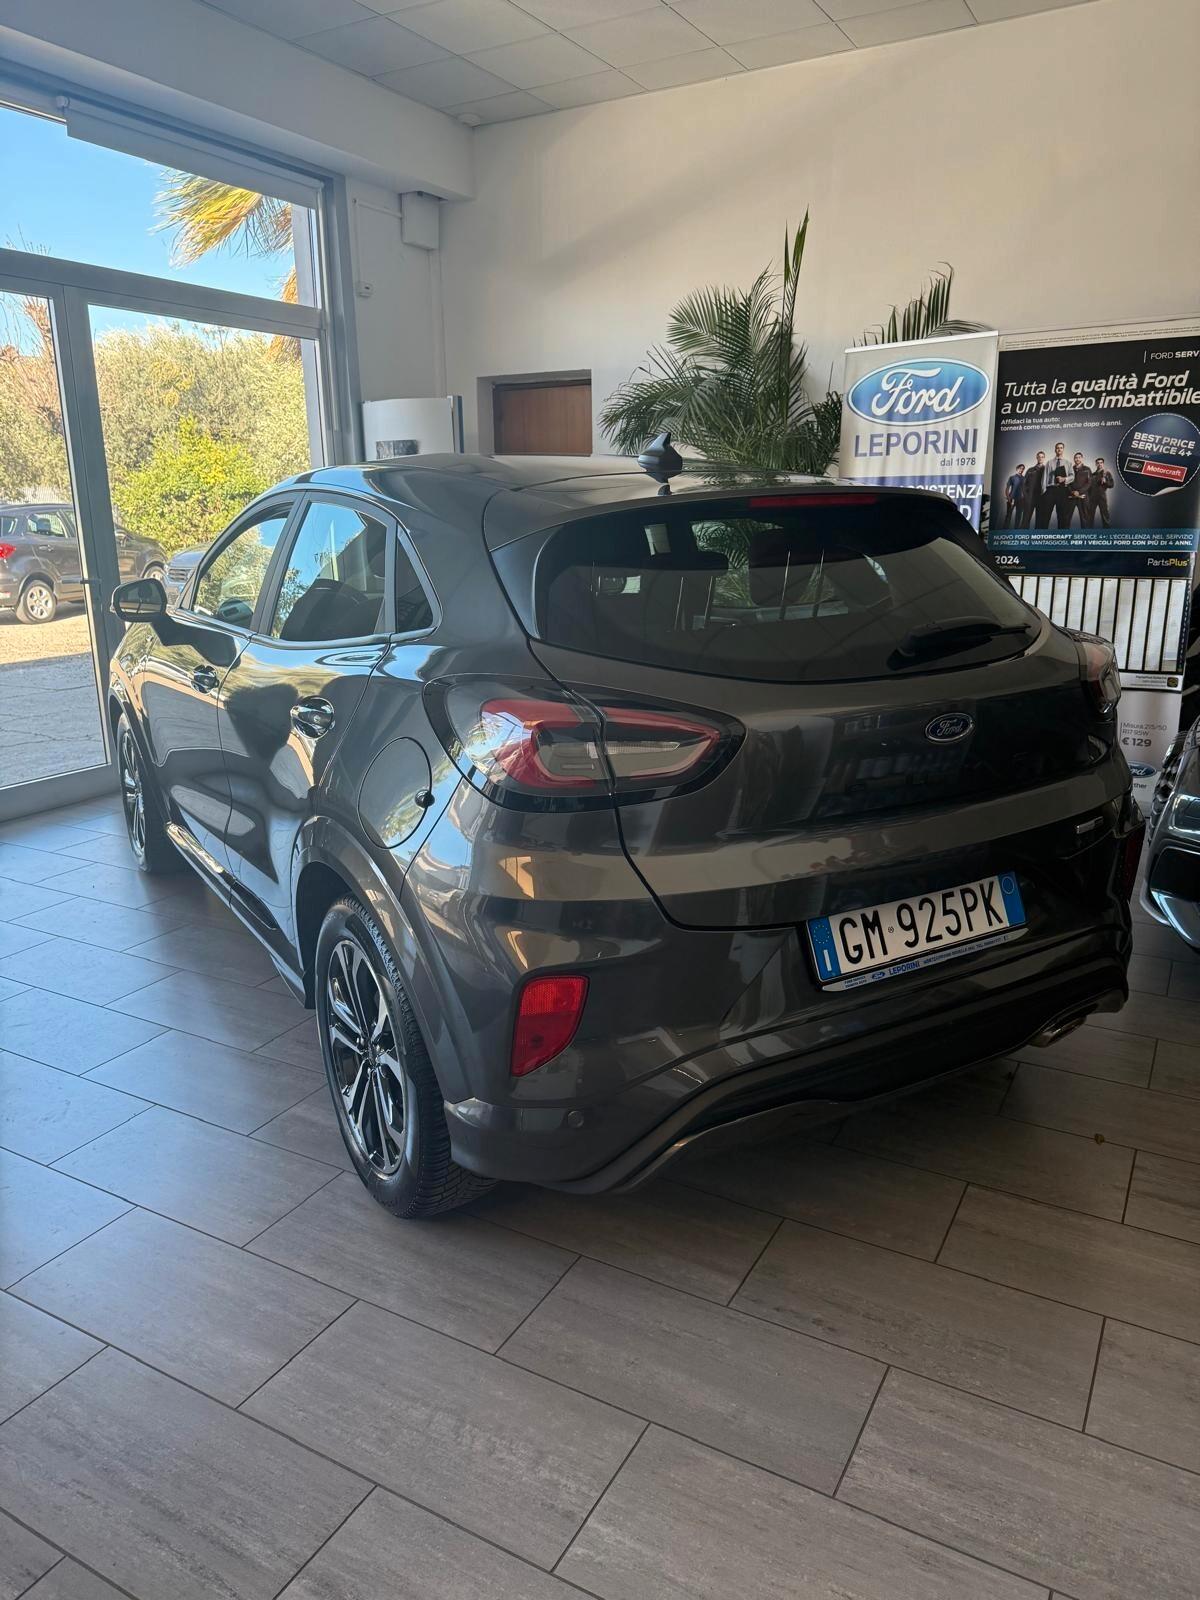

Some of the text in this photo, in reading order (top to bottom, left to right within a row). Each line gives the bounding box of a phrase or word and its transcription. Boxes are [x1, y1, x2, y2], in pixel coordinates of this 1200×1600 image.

[1151, 350, 1200, 360] FORD SERV
[871, 367, 964, 416] Ford
[1004, 370, 1190, 398] Tutta la qualità Ford
[1001, 388, 1200, 415] a un prezzo imbattibile
[854, 428, 978, 457] LEPORINI
[1134, 432, 1195, 449] BEST PRICE
[1131, 441, 1192, 457] SERVICE 4+
[940, 457, 976, 466] dal 1978
[1146, 465, 1182, 476] Motorcraft
[995, 556, 1020, 564] 2024
[1147, 558, 1188, 567] PartsPlus
[936, 719, 964, 735] Ford
[1121, 737, 1152, 747] € 129
[838, 910, 888, 964] GM
[896, 880, 1003, 949] 925PK
[823, 949, 832, 972] I
[888, 961, 920, 975] LEPORINI
